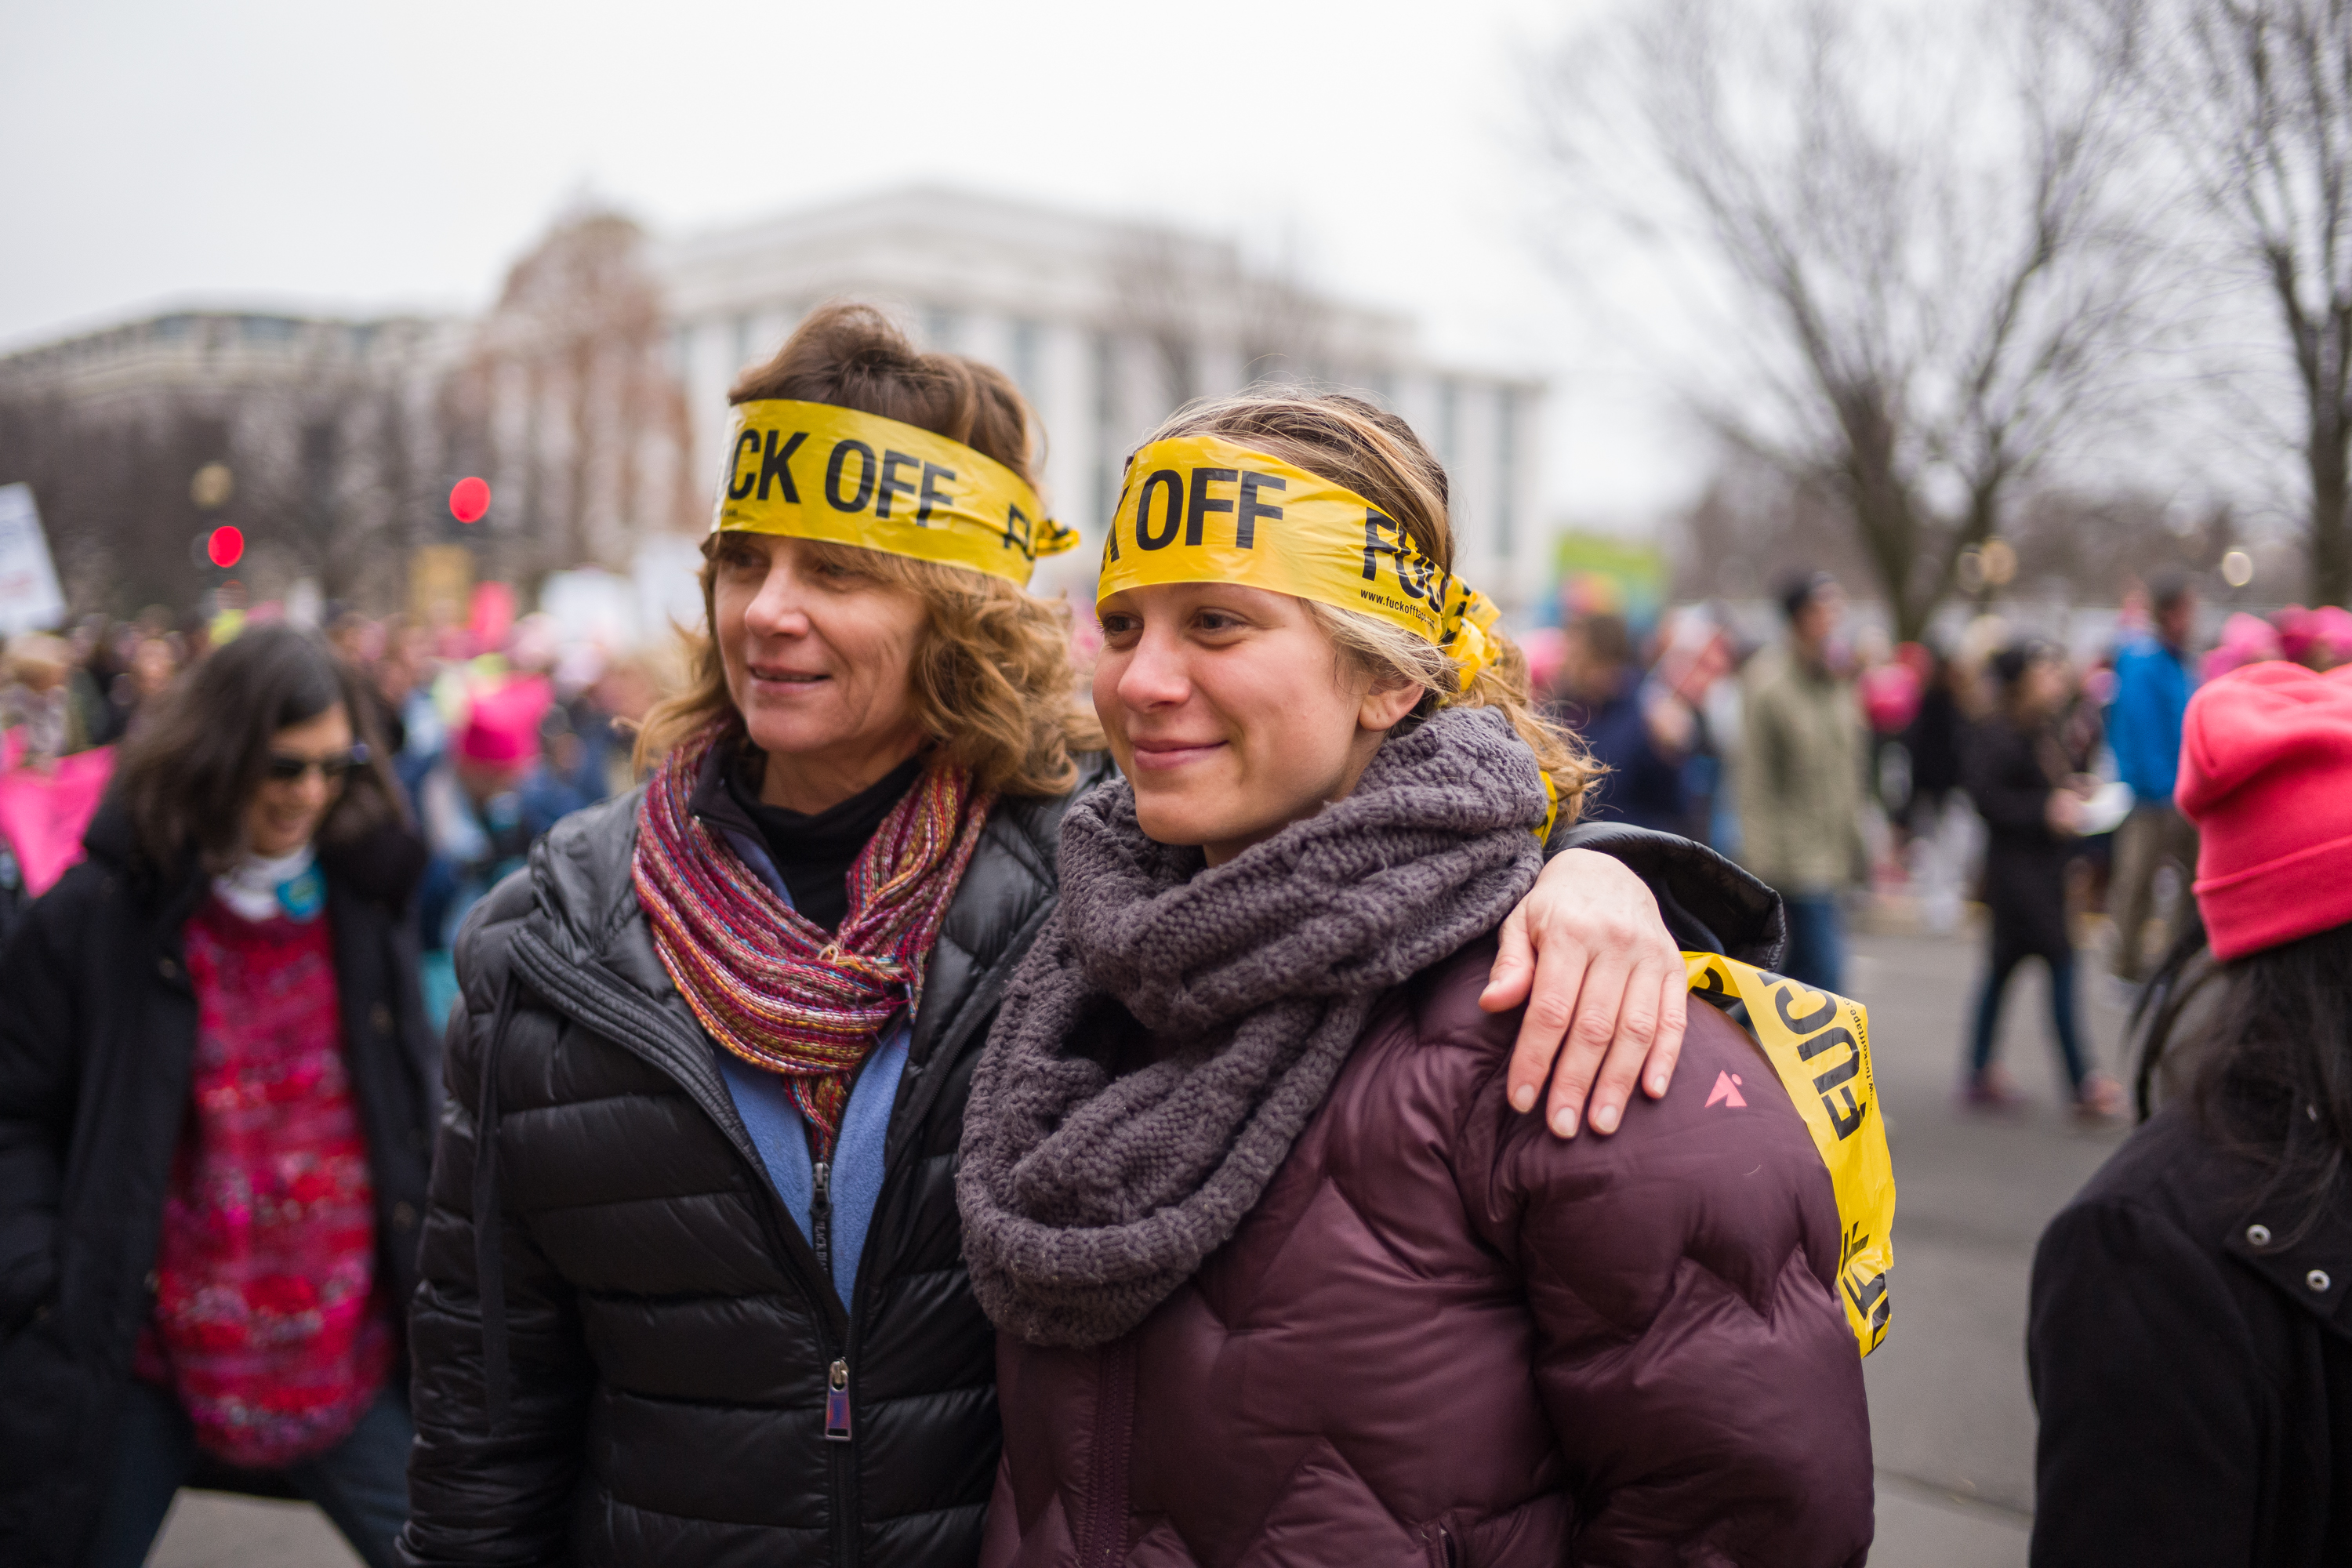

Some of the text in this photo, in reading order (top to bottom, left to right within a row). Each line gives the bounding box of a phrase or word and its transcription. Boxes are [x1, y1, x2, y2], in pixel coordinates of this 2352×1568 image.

[728, 429, 810, 504] CK
[826, 440, 955, 527] OFF
[1136, 468, 1286, 551] OFF
[1757, 971, 1867, 1141] FUC
